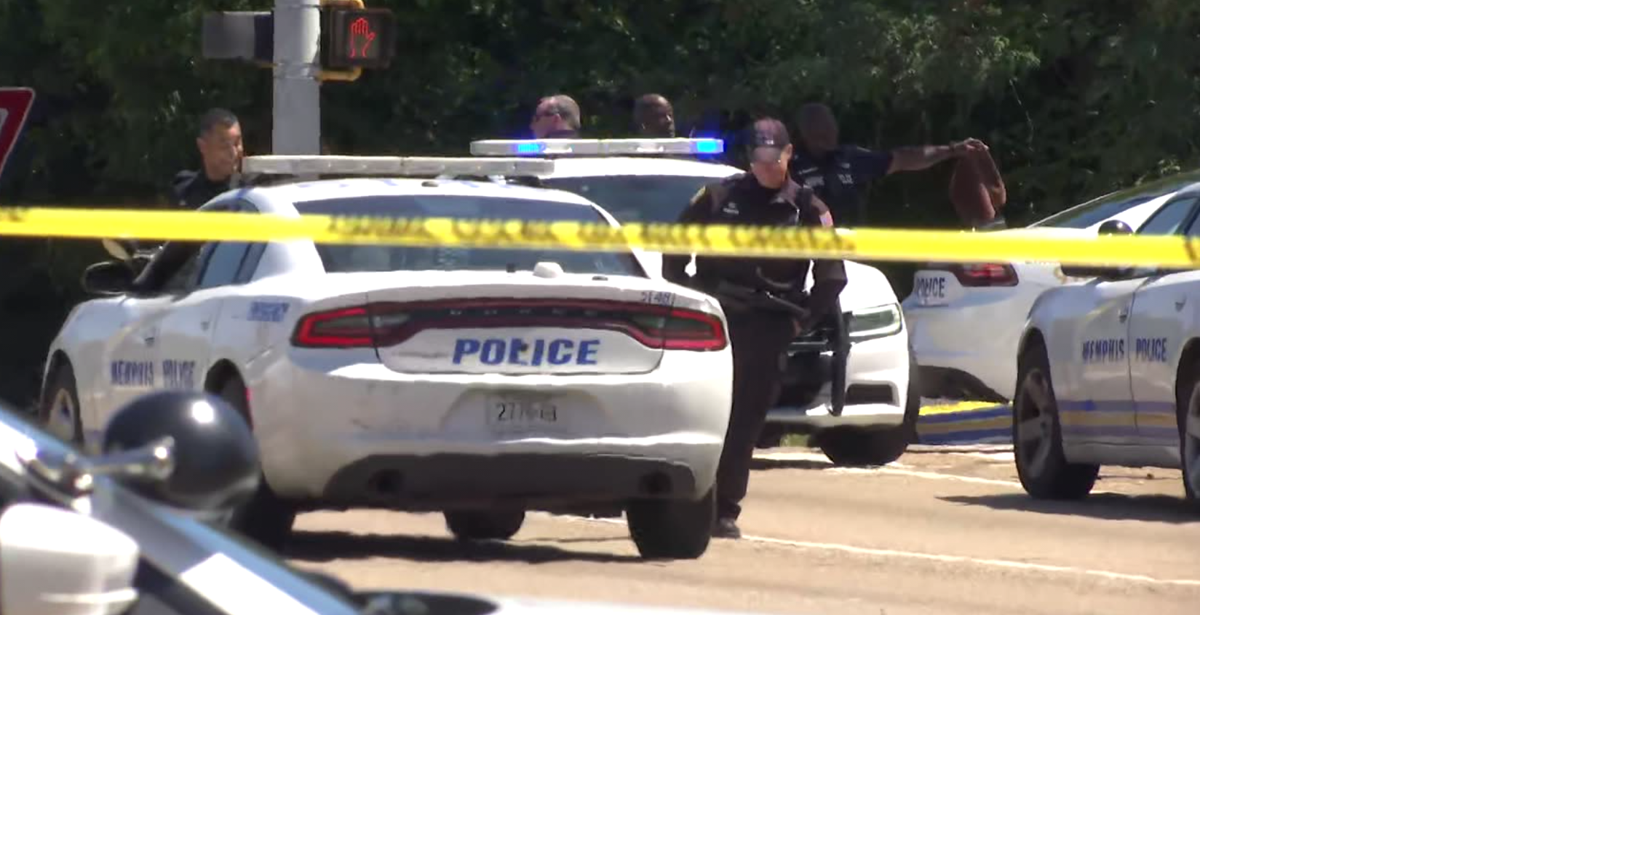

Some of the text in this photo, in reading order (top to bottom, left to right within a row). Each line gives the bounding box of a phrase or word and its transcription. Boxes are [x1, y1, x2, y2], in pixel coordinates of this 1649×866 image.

[452, 337, 600, 366] POLICE
[1082, 337, 1167, 362] MEMPHIS POLICE
